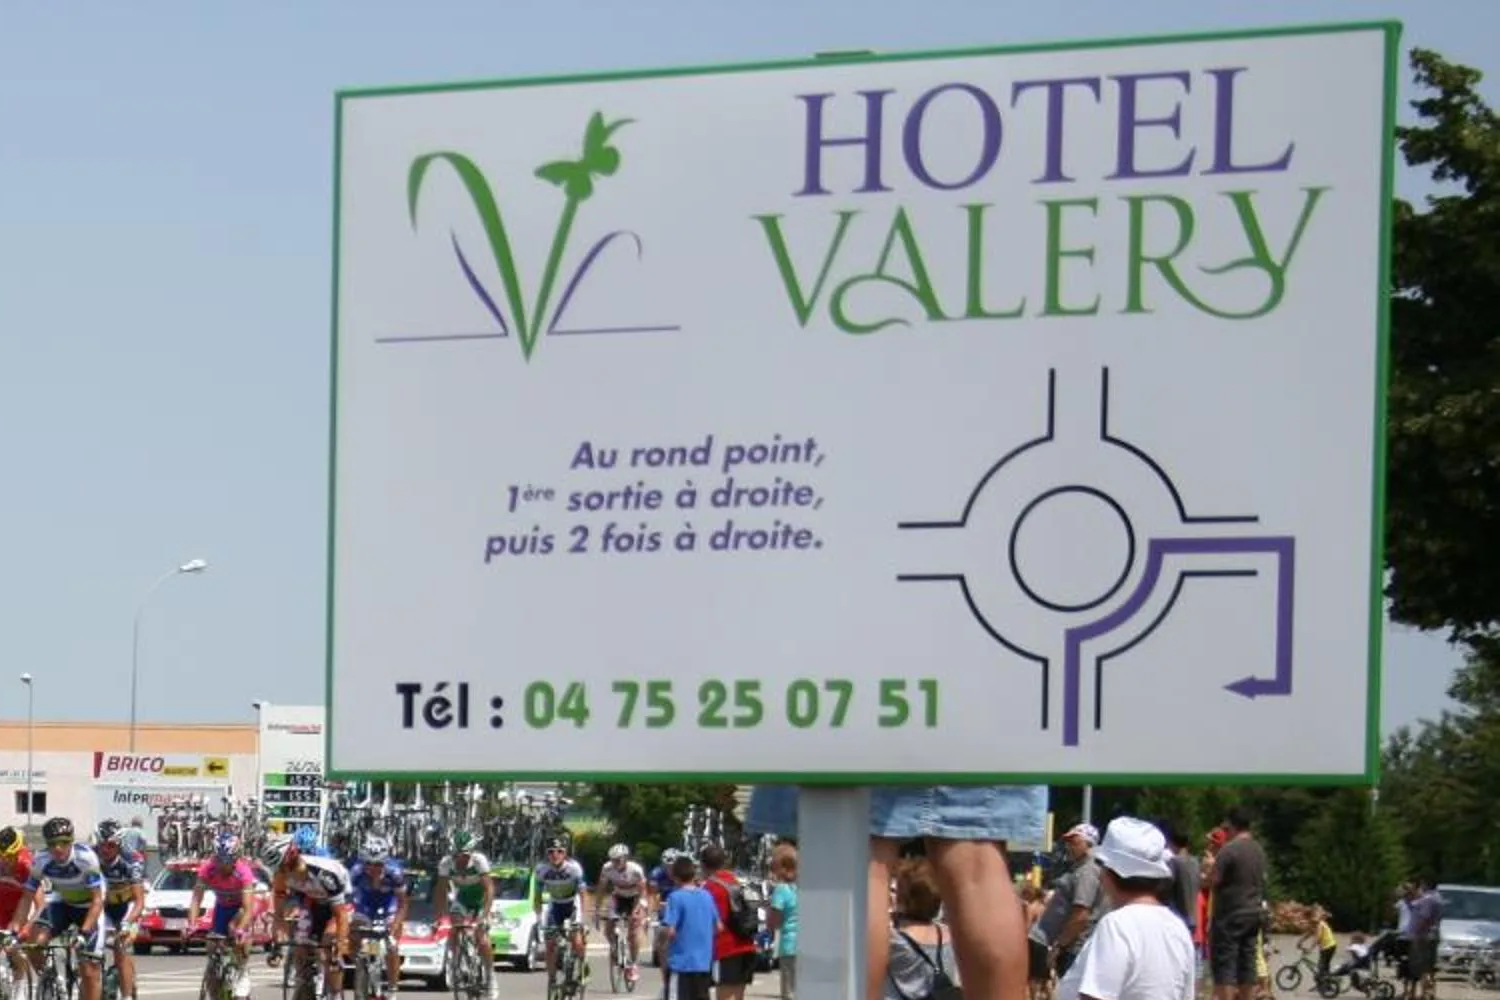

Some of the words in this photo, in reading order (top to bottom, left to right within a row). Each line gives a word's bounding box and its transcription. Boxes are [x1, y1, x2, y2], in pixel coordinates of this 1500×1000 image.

[793, 67, 1296, 197] HOTEL
[750, 186, 1332, 336] VALERY
[570, 441, 619, 470] Au
[630, 434, 714, 468] rond
[721, 433, 825, 475] point,
[508, 485, 555, 513] 1ère
[566, 479, 664, 512] sortie
[675, 479, 698, 510] à
[710, 476, 824, 510] droite,
[483, 524, 555, 564] puis
[568, 524, 590, 554] 2
[601, 521, 662, 553] fois
[673, 521, 697, 552] à
[708, 519, 823, 552] droite.
[394, 681, 470, 730] Tél
[523, 679, 591, 730] 04
[611, 679, 677, 729] 75
[696, 678, 765, 730] 25
[785, 678, 854, 729] 07
[877, 678, 939, 729] 51
[107, 756, 165, 773] BRICO
